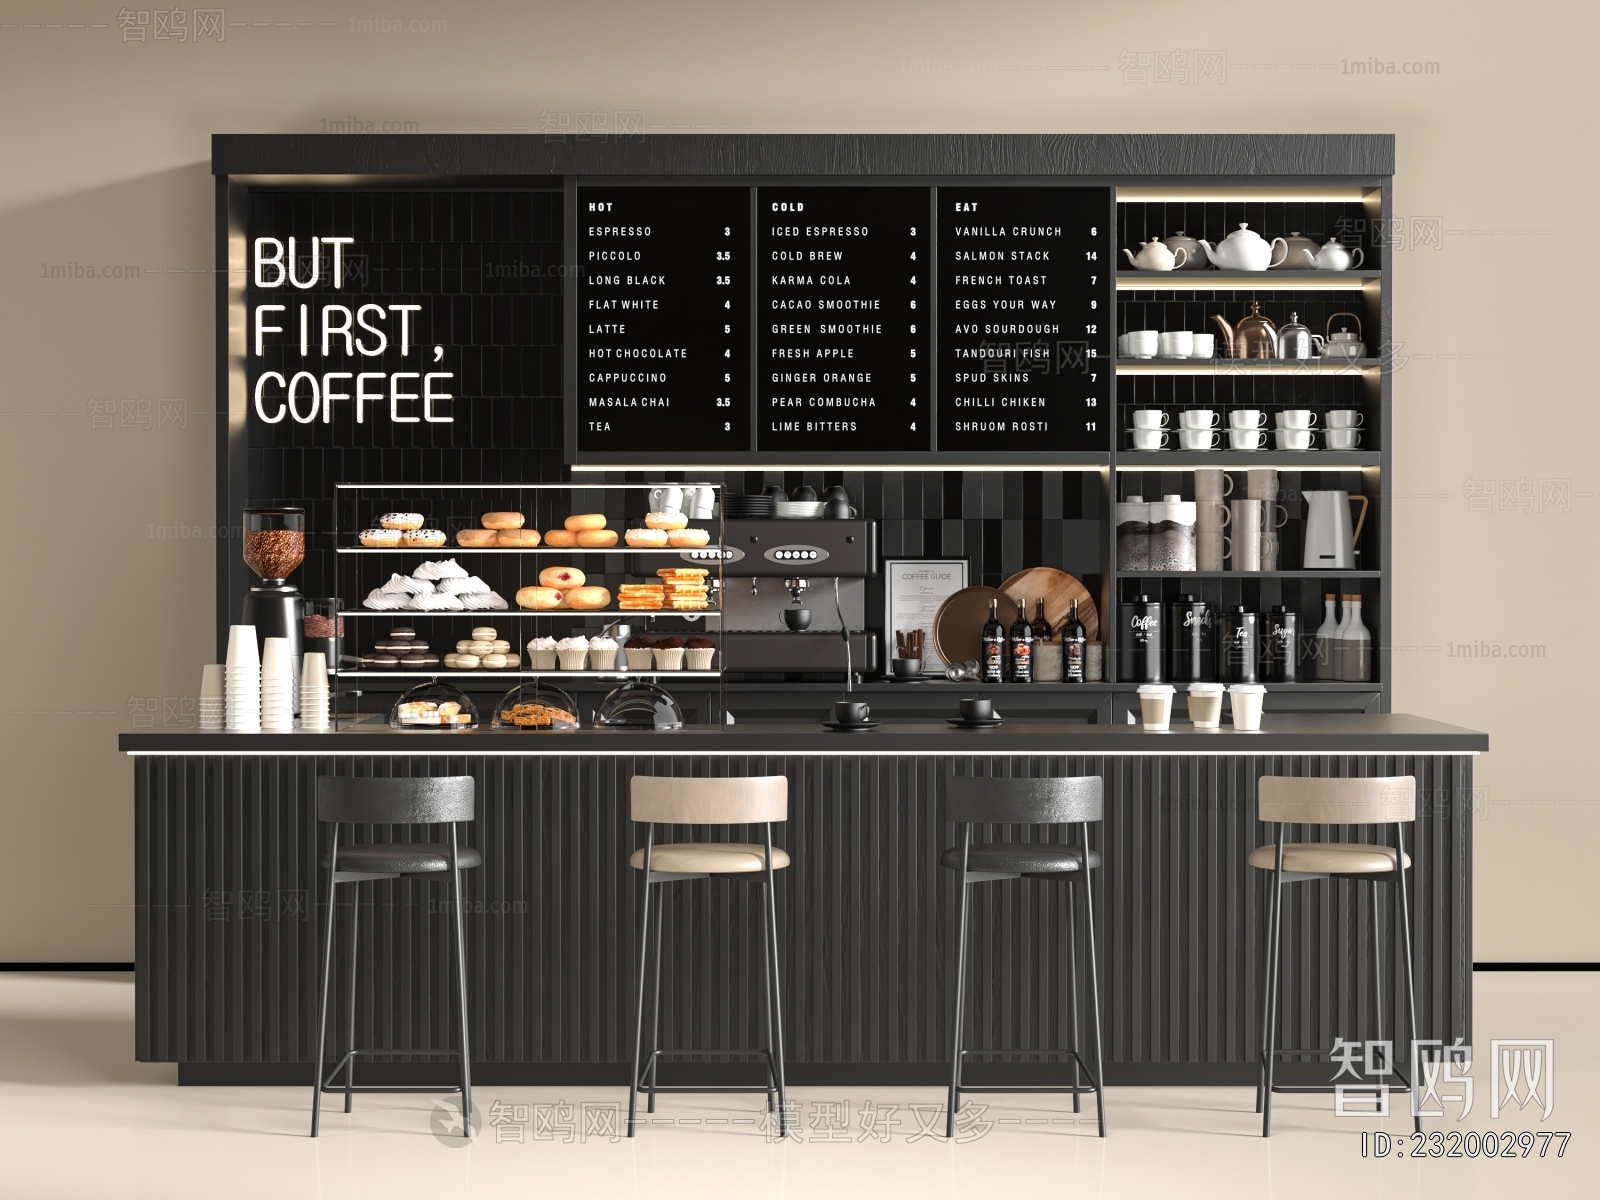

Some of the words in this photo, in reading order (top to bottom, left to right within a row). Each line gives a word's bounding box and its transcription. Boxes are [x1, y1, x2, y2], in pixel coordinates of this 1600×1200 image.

[588, 202, 613, 212] HOT
[771, 202, 804, 212] COLD
[955, 202, 978, 212] EAT
[588, 226, 651, 237] ESPRESSO
[724, 226, 731, 237] 3
[771, 226, 800, 237] ICED
[806, 226, 869, 237] ESPRESSO
[910, 226, 917, 237] 3
[954, 226, 1006, 237] VANILLA
[1012, 226, 1061, 237] CRUNCH
[1090, 226, 1098, 237] 6
[588, 250, 641, 261] PICCOLO
[716, 251, 731, 261] 3.5
[771, 250, 803, 261] COLD
[809, 251, 843, 261] BREW
[909, 251, 917, 261] 4
[955, 250, 1004, 261] SALMON
[1010, 250, 1050, 261] STACK
[1085, 251, 1098, 261] 14
[254, 236, 355, 289] BUT
[588, 275, 620, 285] LONG
[626, 275, 666, 285] BLACK
[716, 275, 731, 286] 3.5
[771, 275, 814, 285] KARMA
[819, 275, 851, 285] COLA
[909, 275, 917, 286] 4
[955, 275, 1002, 285] FRENCH
[1008, 275, 1047, 285] TOAST
[1090, 275, 1098, 286] 7
[588, 299, 618, 310] FLAT
[621, 299, 659, 310] WHITE
[724, 300, 731, 310] 4
[771, 299, 812, 310] CACAO
[818, 299, 880, 310] SMOOTHIE
[909, 299, 917, 310] 6
[955, 299, 987, 310] EGGS
[992, 299, 1025, 310] YOUR
[1030, 299, 1056, 310] WAY
[1090, 299, 1098, 310] 9
[254, 303, 444, 362] FIRST,
[588, 324, 626, 334] LATTE
[724, 324, 731, 334] 5
[771, 324, 811, 334] GREEN
[820, 324, 882, 334] SMOOTHIE
[909, 324, 917, 334] 6
[954, 324, 979, 334] AVO
[984, 324, 1059, 334] SOURDOUGH
[1085, 324, 1097, 334] 12
[588, 348, 612, 359] HOT
[615, 348, 687, 359] CHOCOLATE
[724, 348, 731, 359] 4
[771, 348, 810, 359] FRESH
[815, 348, 854, 359] APPLE
[910, 348, 917, 359] 5
[955, 348, 1016, 359] TANDOURI
[1022, 348, 1050, 359] FISH
[1085, 348, 1097, 359] 15
[588, 372, 667, 383] CAPPUCCINO
[724, 373, 731, 383] 5
[771, 372, 817, 383] GINGER
[823, 372, 872, 383] ORANGE
[910, 373, 917, 383] 5
[955, 372, 987, 383] SPUD
[993, 372, 1029, 383] SKINS
[1090, 373, 1097, 383] 7
[254, 371, 454, 424] COFFEE
[588, 397, 638, 407] MASALA
[641, 397, 670, 407] CHAI
[716, 397, 731, 407] 3.5
[771, 397, 802, 407] PEAR
[808, 397, 876, 407] COMBUCHA
[909, 397, 917, 407] 4
[955, 397, 995, 407] CHILLI
[1001, 397, 1045, 407] CHIKEN
[1085, 397, 1097, 407] 13
[588, 421, 611, 432] TEA
[724, 421, 731, 432] 3
[771, 421, 800, 432] LIME
[806, 421, 857, 432] BITTERS
[909, 421, 917, 432] 4
[955, 421, 1006, 432] SHRUOM
[1012, 421, 1048, 432] ROSTI
[1085, 421, 1096, 432] 11
[1131, 615, 1158, 630] Coffee
[1183, 609, 1212, 629] Snacks
[1236, 626, 1248, 639] Tea
[1272, 623, 1295, 639] Sugar
